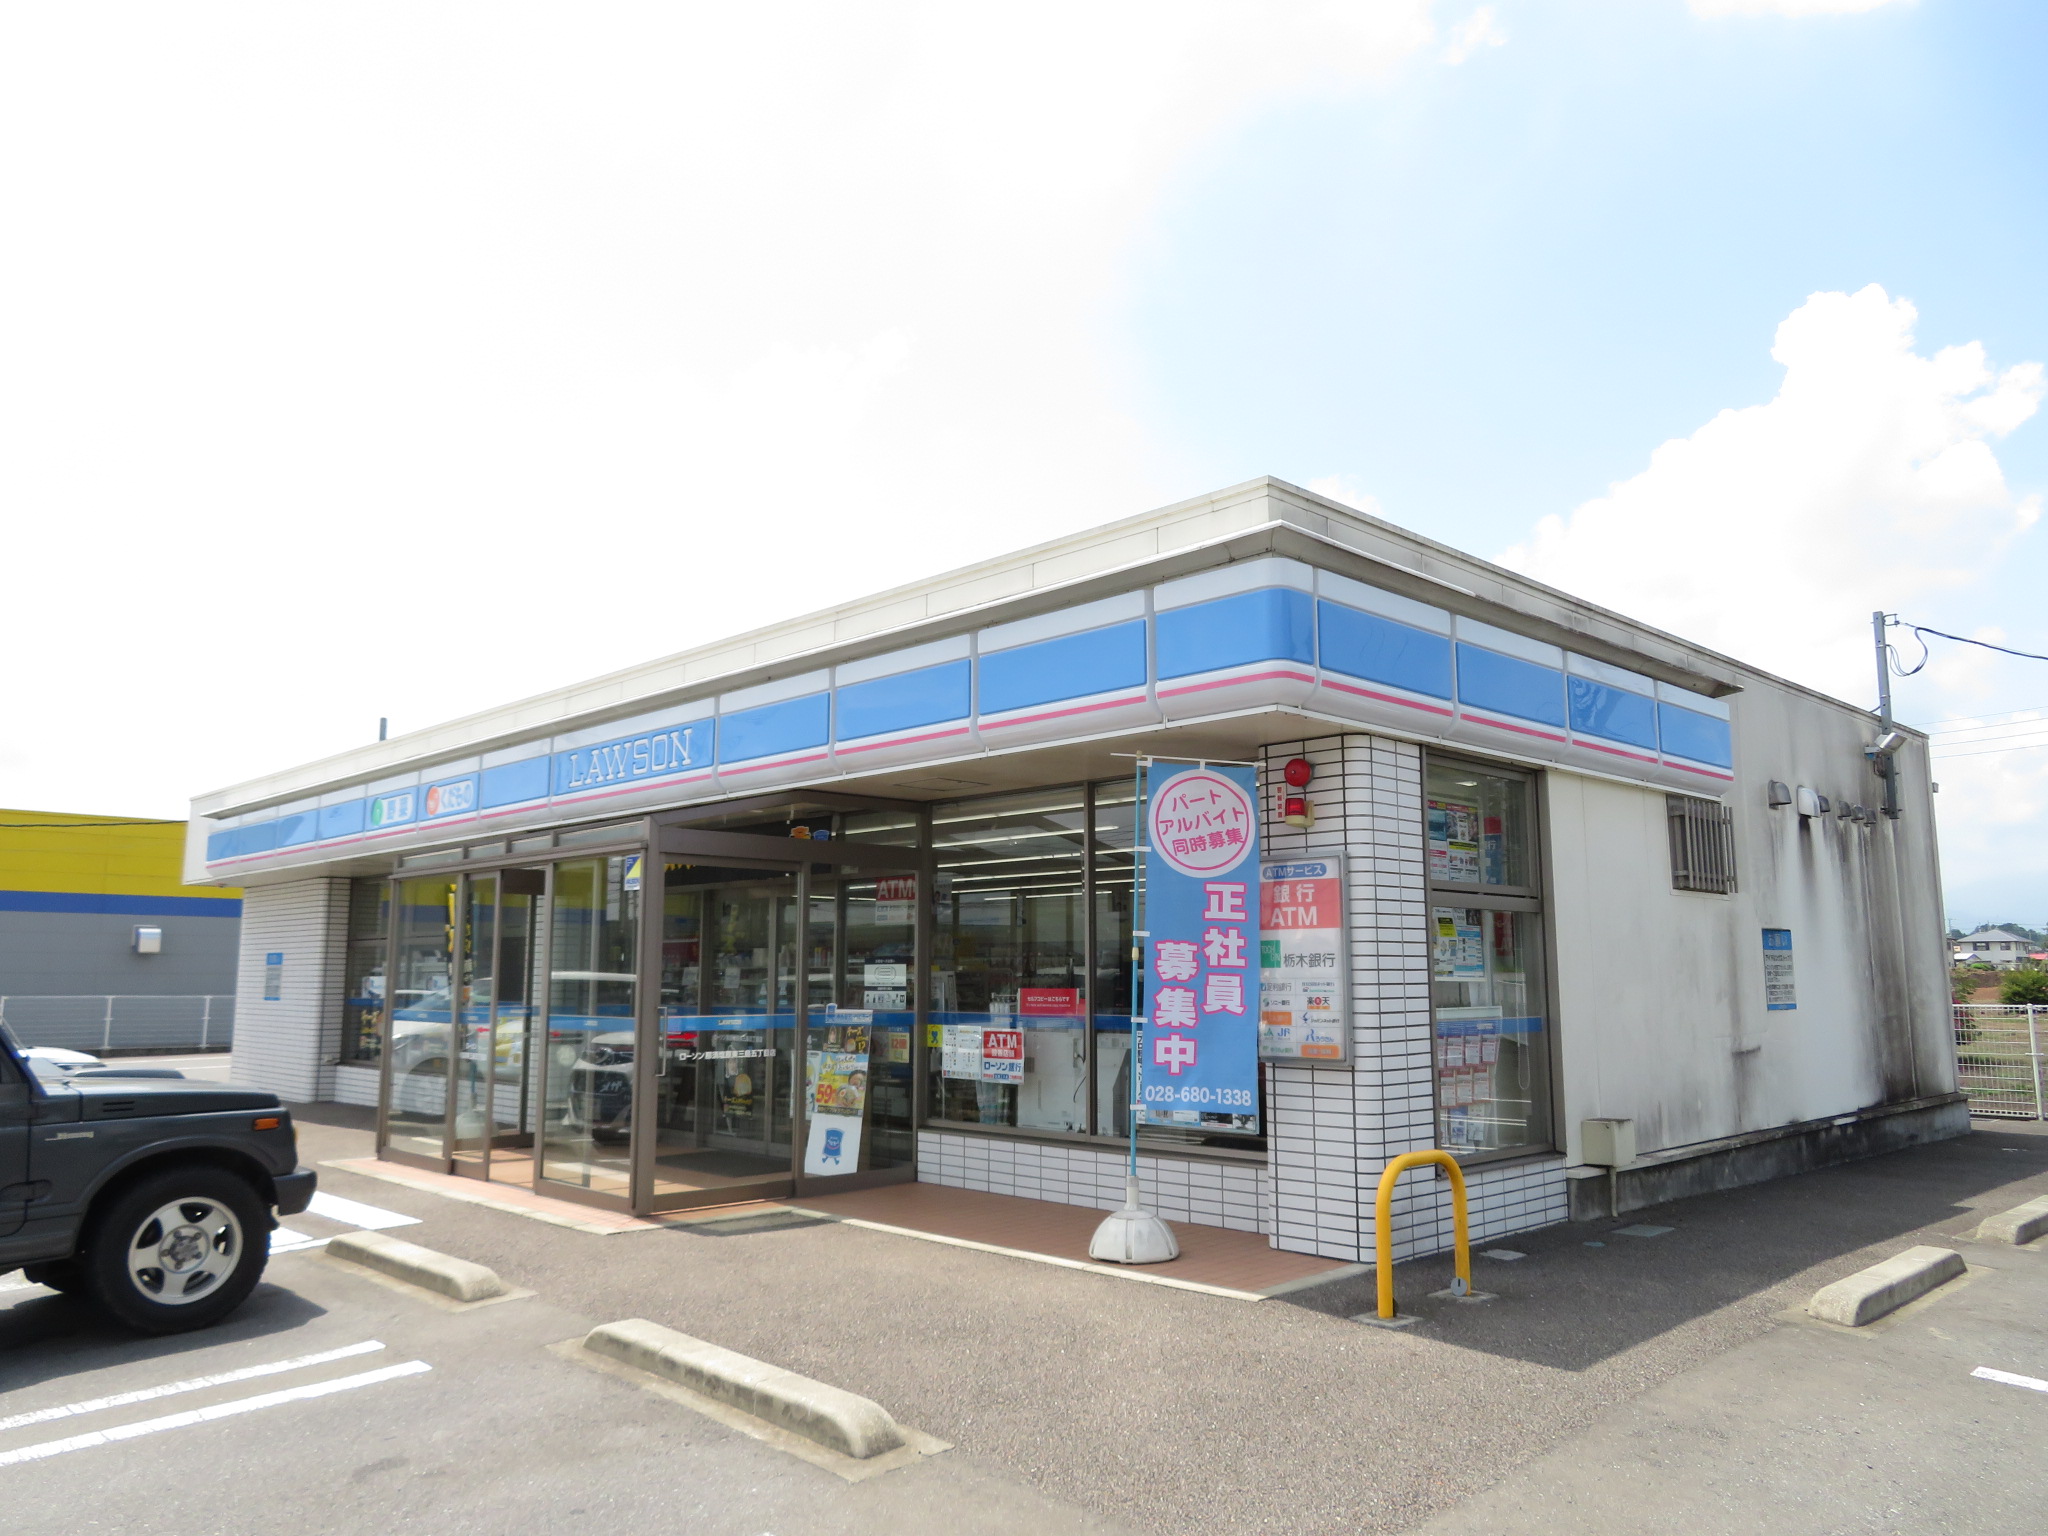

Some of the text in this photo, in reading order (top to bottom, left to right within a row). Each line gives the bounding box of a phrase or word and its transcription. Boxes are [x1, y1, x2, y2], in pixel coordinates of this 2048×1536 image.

[569, 728, 693, 788] LAWSON
[1172, 789, 1222, 812] パート
[1159, 807, 1245, 836] アルバイト
[1172, 828, 1244, 856] 同時募集
[1265, 865, 1323, 878] ATMサービス
[877, 878, 913, 899] ATM
[1273, 883, 1315, 904] 銀行
[1270, 905, 1318, 927] ATM
[1202, 881, 1247, 1015] 正社員
[1283, 952, 1336, 968] 栃木銀行
[1154, 941, 1199, 1074] 募集中
[987, 1033, 1017, 1048] ATM
[984, 1061, 1022, 1073] ローソン銀行
[1145, 1085, 1252, 1106] 028-680-1338
